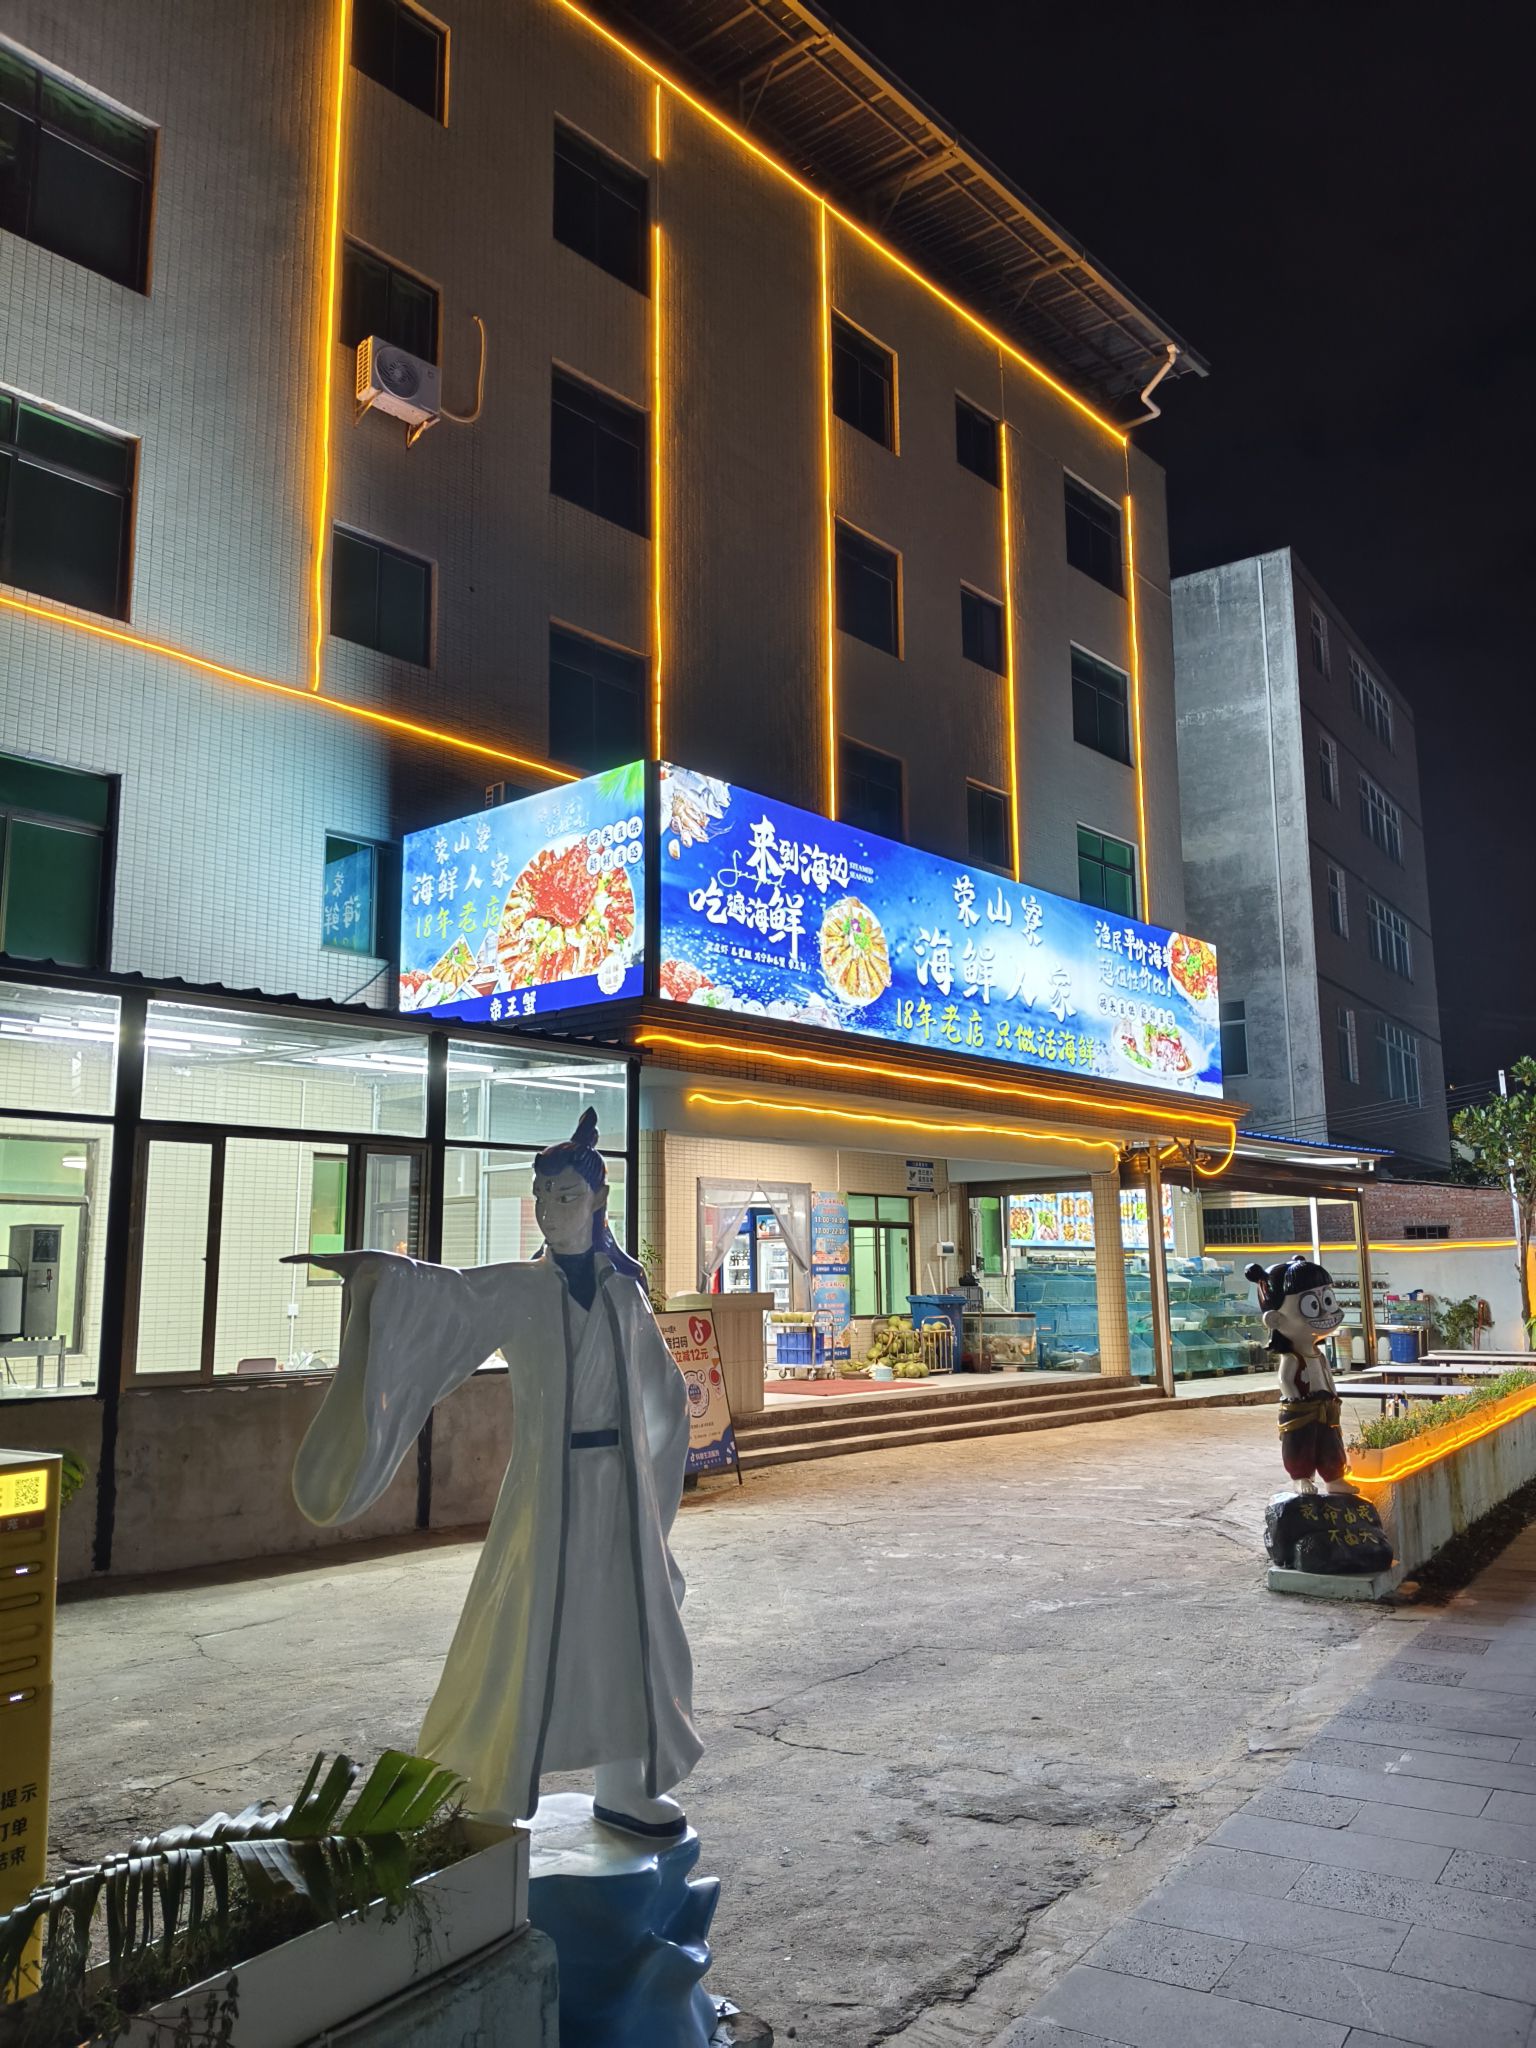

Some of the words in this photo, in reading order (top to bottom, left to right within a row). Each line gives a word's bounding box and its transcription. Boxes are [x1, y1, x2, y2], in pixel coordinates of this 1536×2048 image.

[746, 814, 850, 893] 来到海边
[412, 853, 512, 906] 海鲜人家
[415, 895, 501, 940] 18年老店
[689, 877, 806, 960] 吃遍海鲜
[952, 874, 1044, 946] 荣山寮
[914, 927, 1078, 1023] 海鲜人家
[489, 990, 538, 1022] 帝王蟹
[896, 997, 985, 1049] 18年老店
[995, 1021, 1096, 1069] 只做活海鲜
[671, 1348, 709, 1364] 立减12元
[1301, 1503, 1374, 1525] 我命由我
[1327, 1529, 1378, 1547] 不由天
[1, 1781, 38, 1810] 提示
